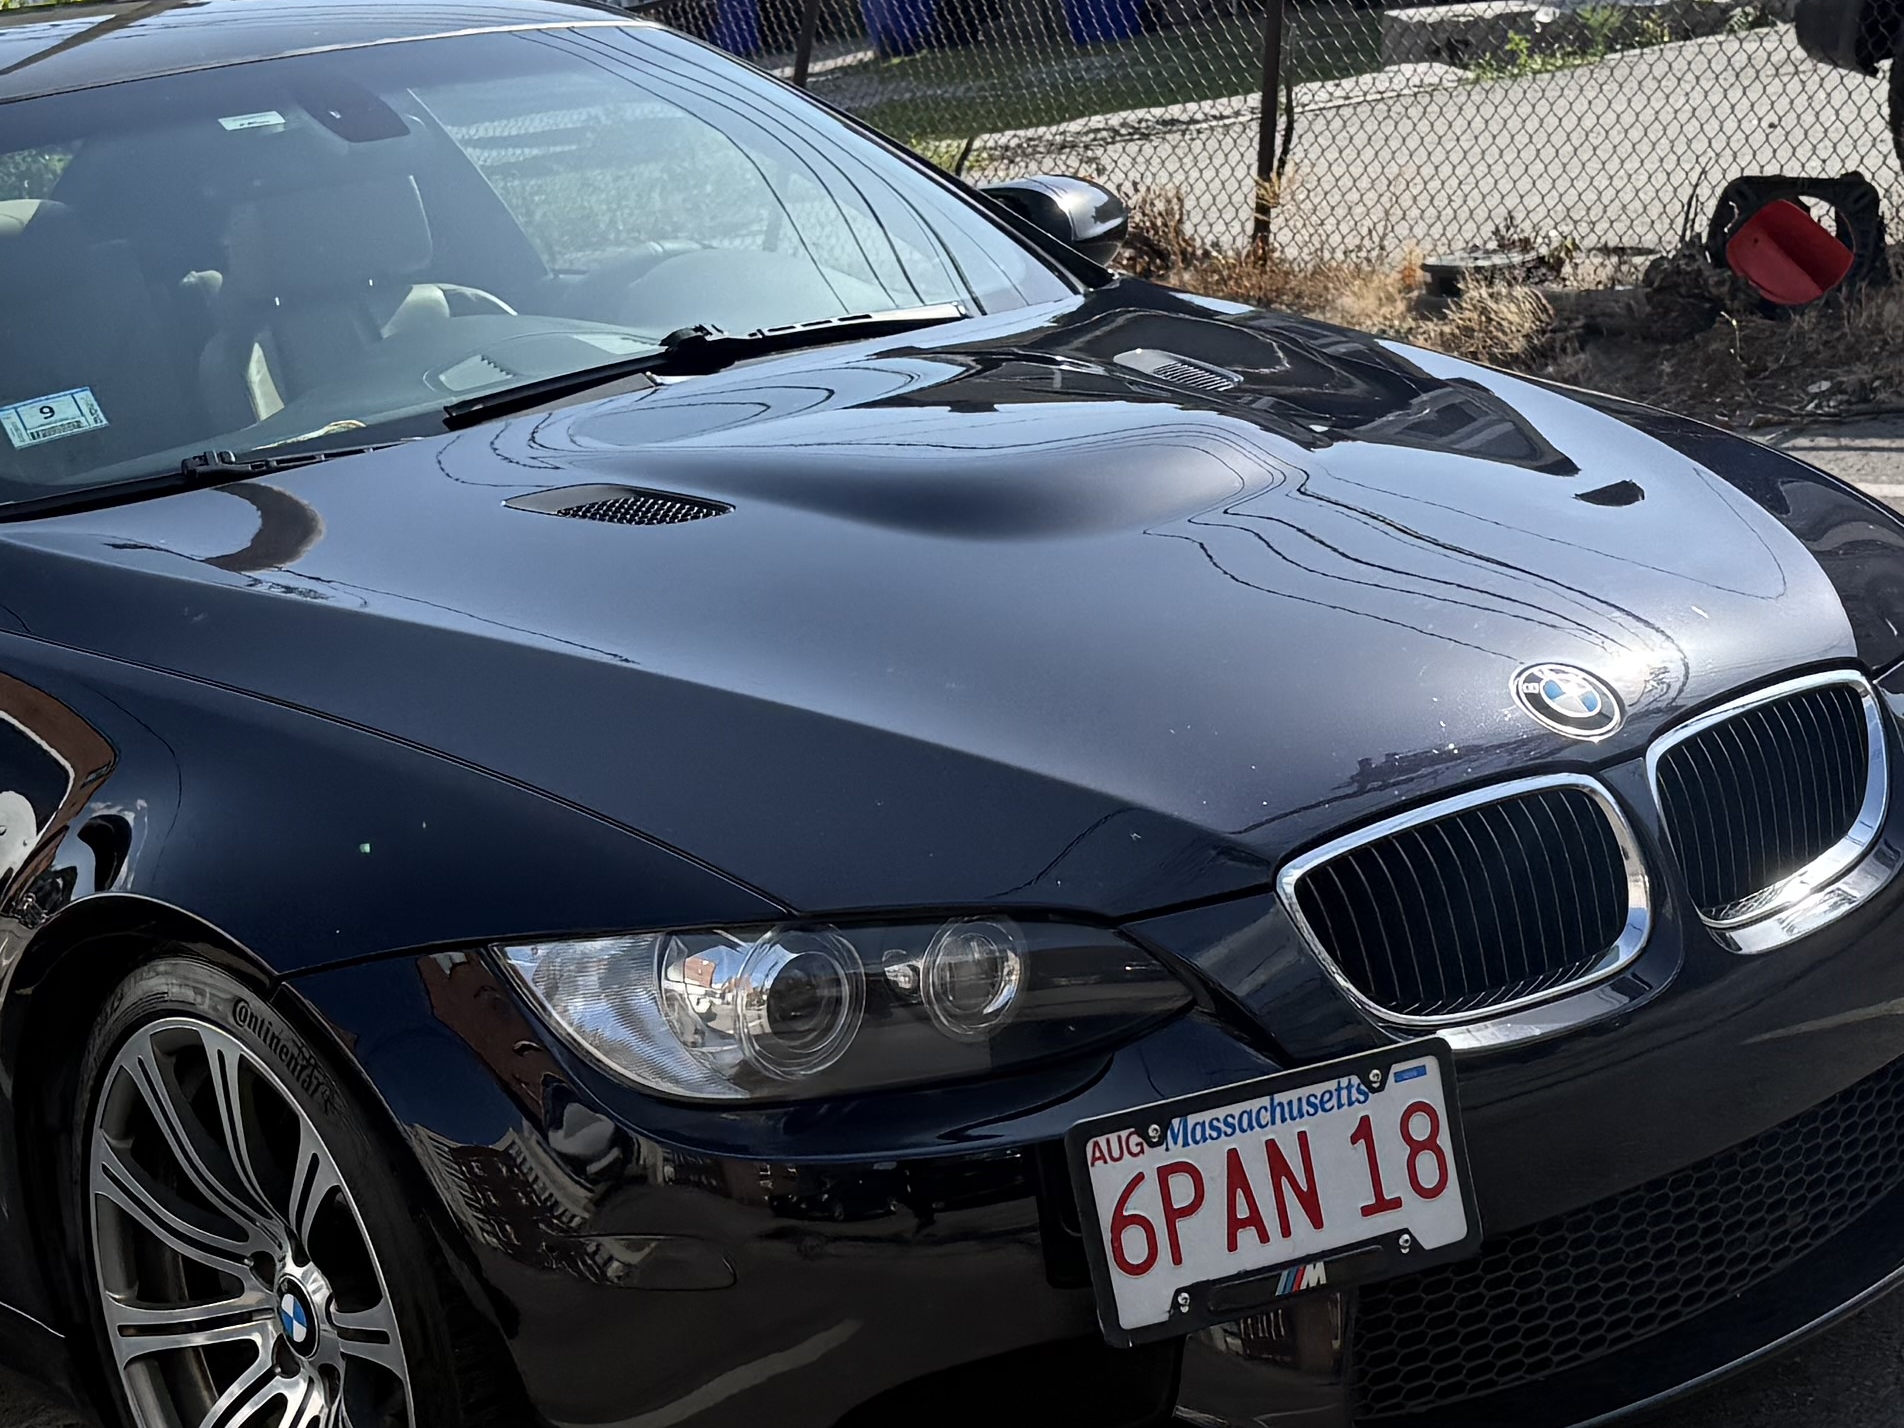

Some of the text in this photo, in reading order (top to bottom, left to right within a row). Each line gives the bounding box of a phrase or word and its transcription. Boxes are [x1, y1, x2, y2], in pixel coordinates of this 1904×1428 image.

[39, 405, 56, 419] 9
[233, 998, 321, 1096] Continental
[1089, 1130, 1145, 1167] AUG
[1165, 1079, 1369, 1151] Massachusetts
[1110, 1101, 1449, 1277] 6PAN 18
